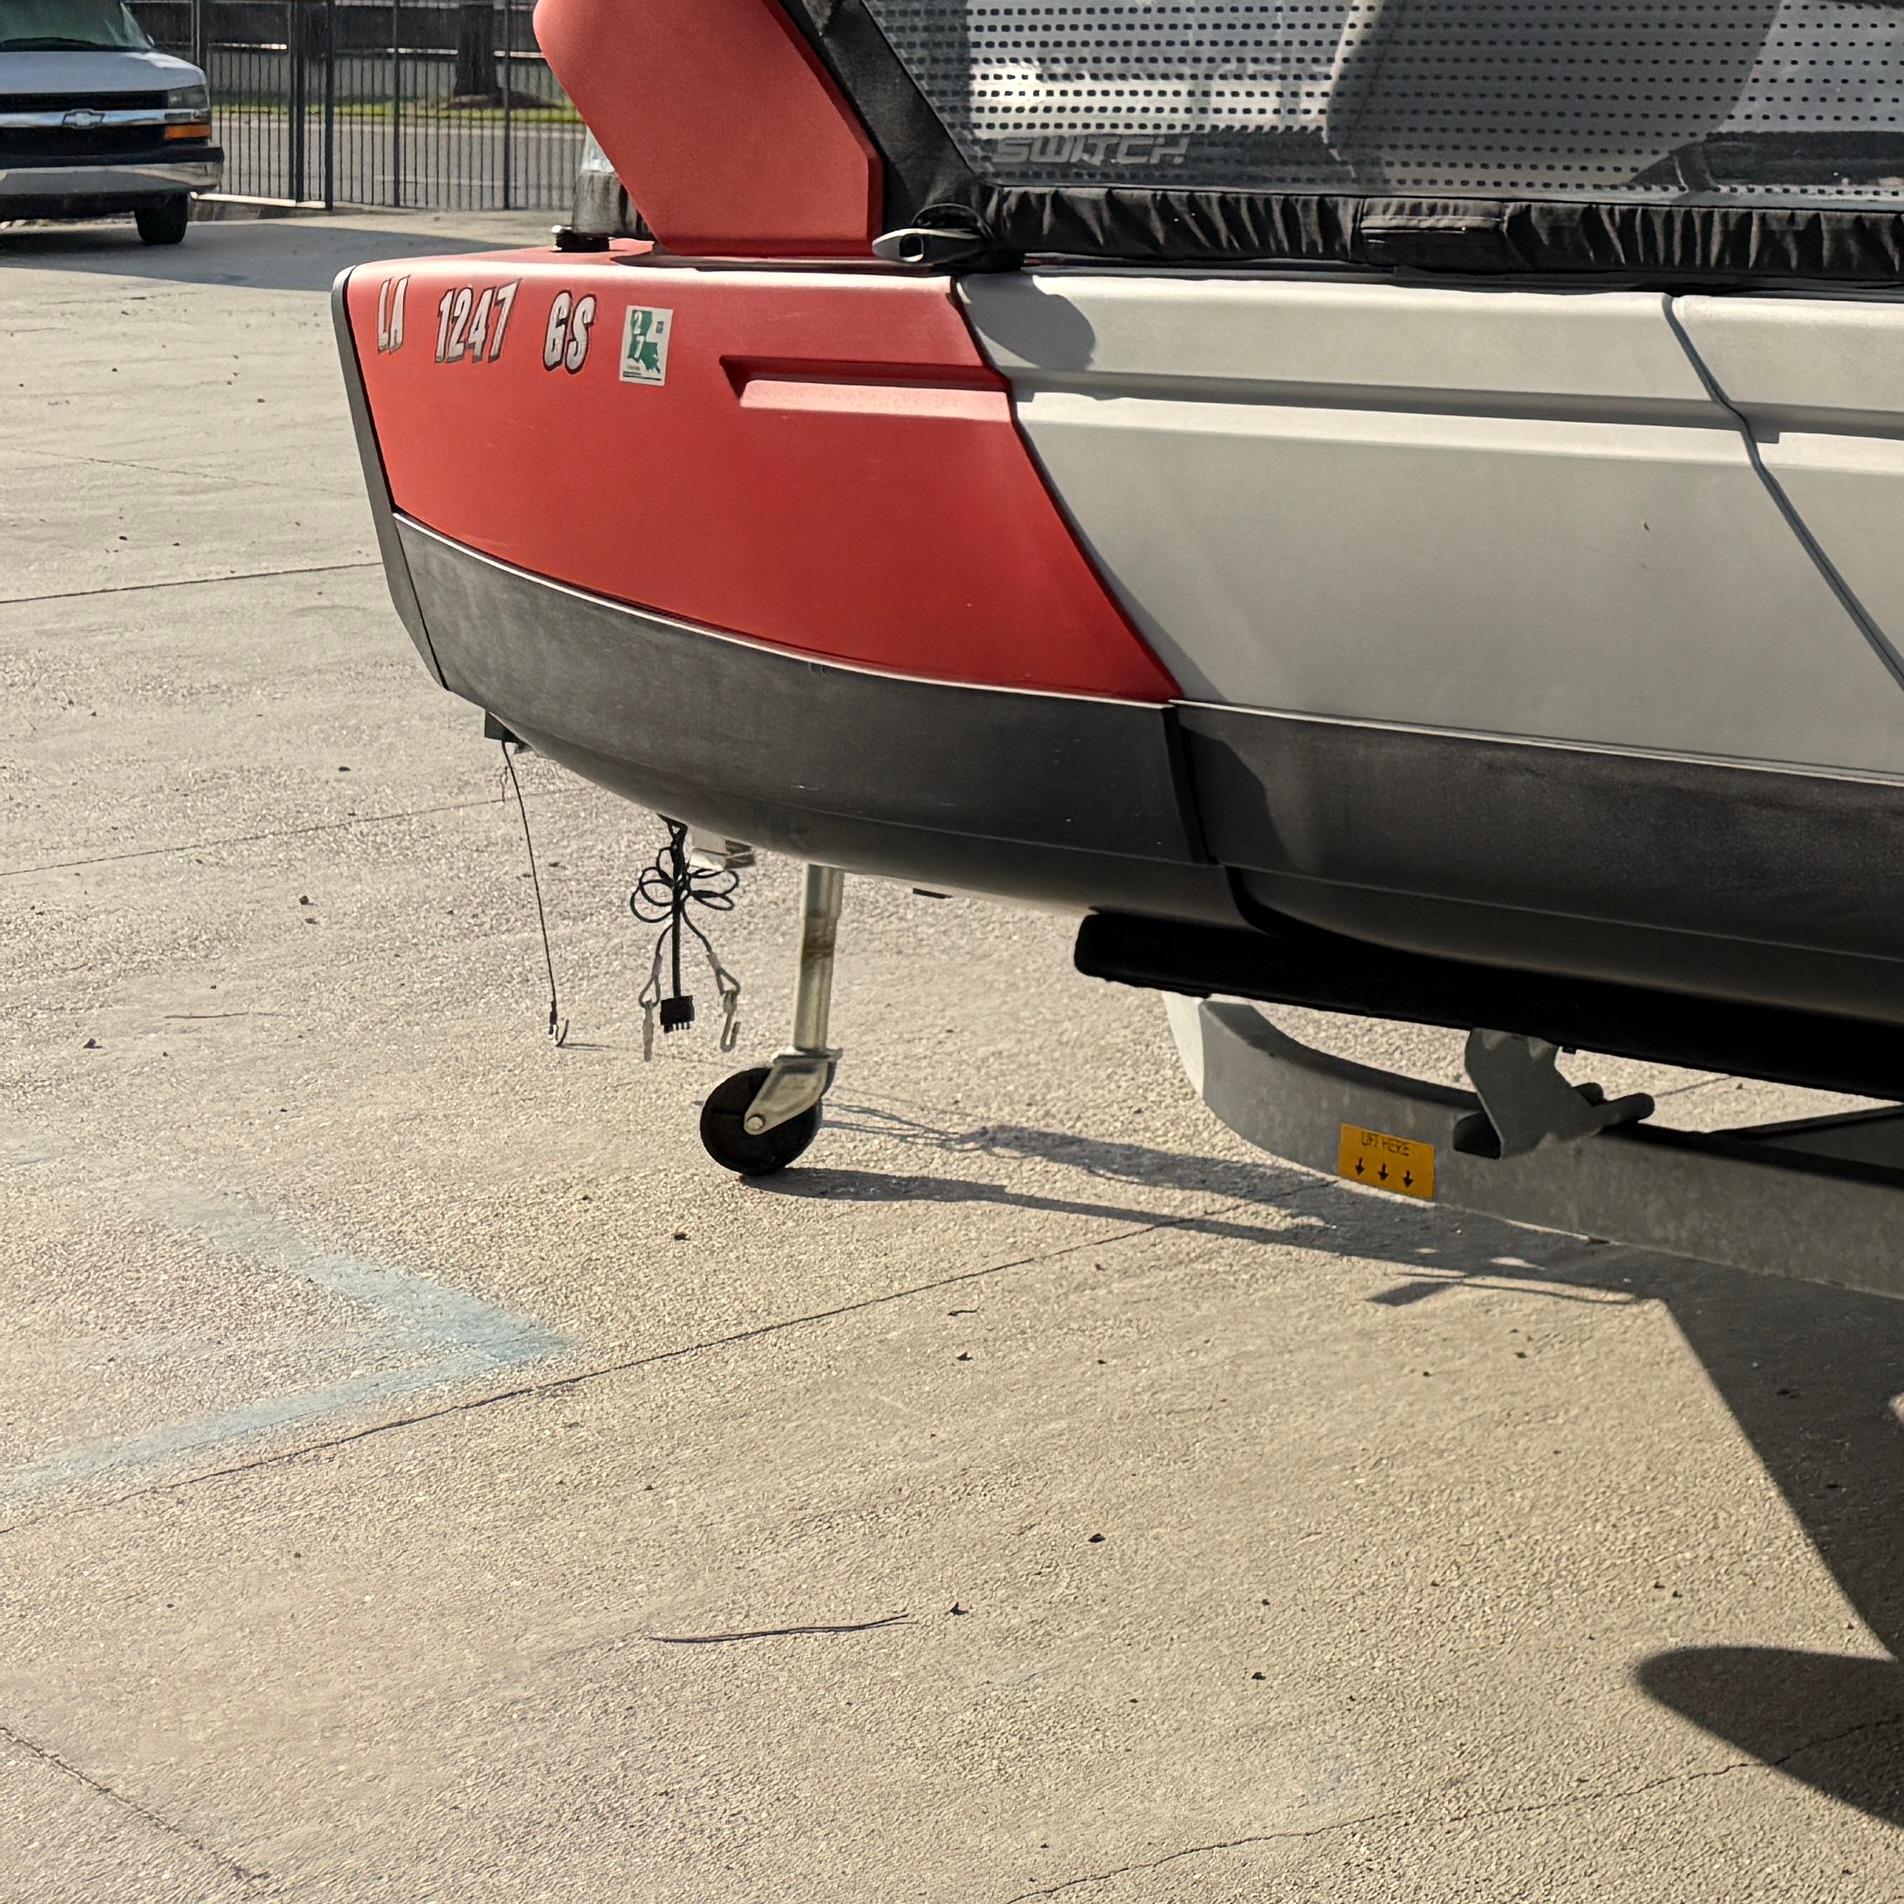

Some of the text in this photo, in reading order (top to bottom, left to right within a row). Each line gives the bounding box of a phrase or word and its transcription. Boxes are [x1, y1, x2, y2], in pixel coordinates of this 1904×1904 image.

[993, 134, 1190, 166] SWITCH
[377, 274, 597, 375] LA 1247 GS
